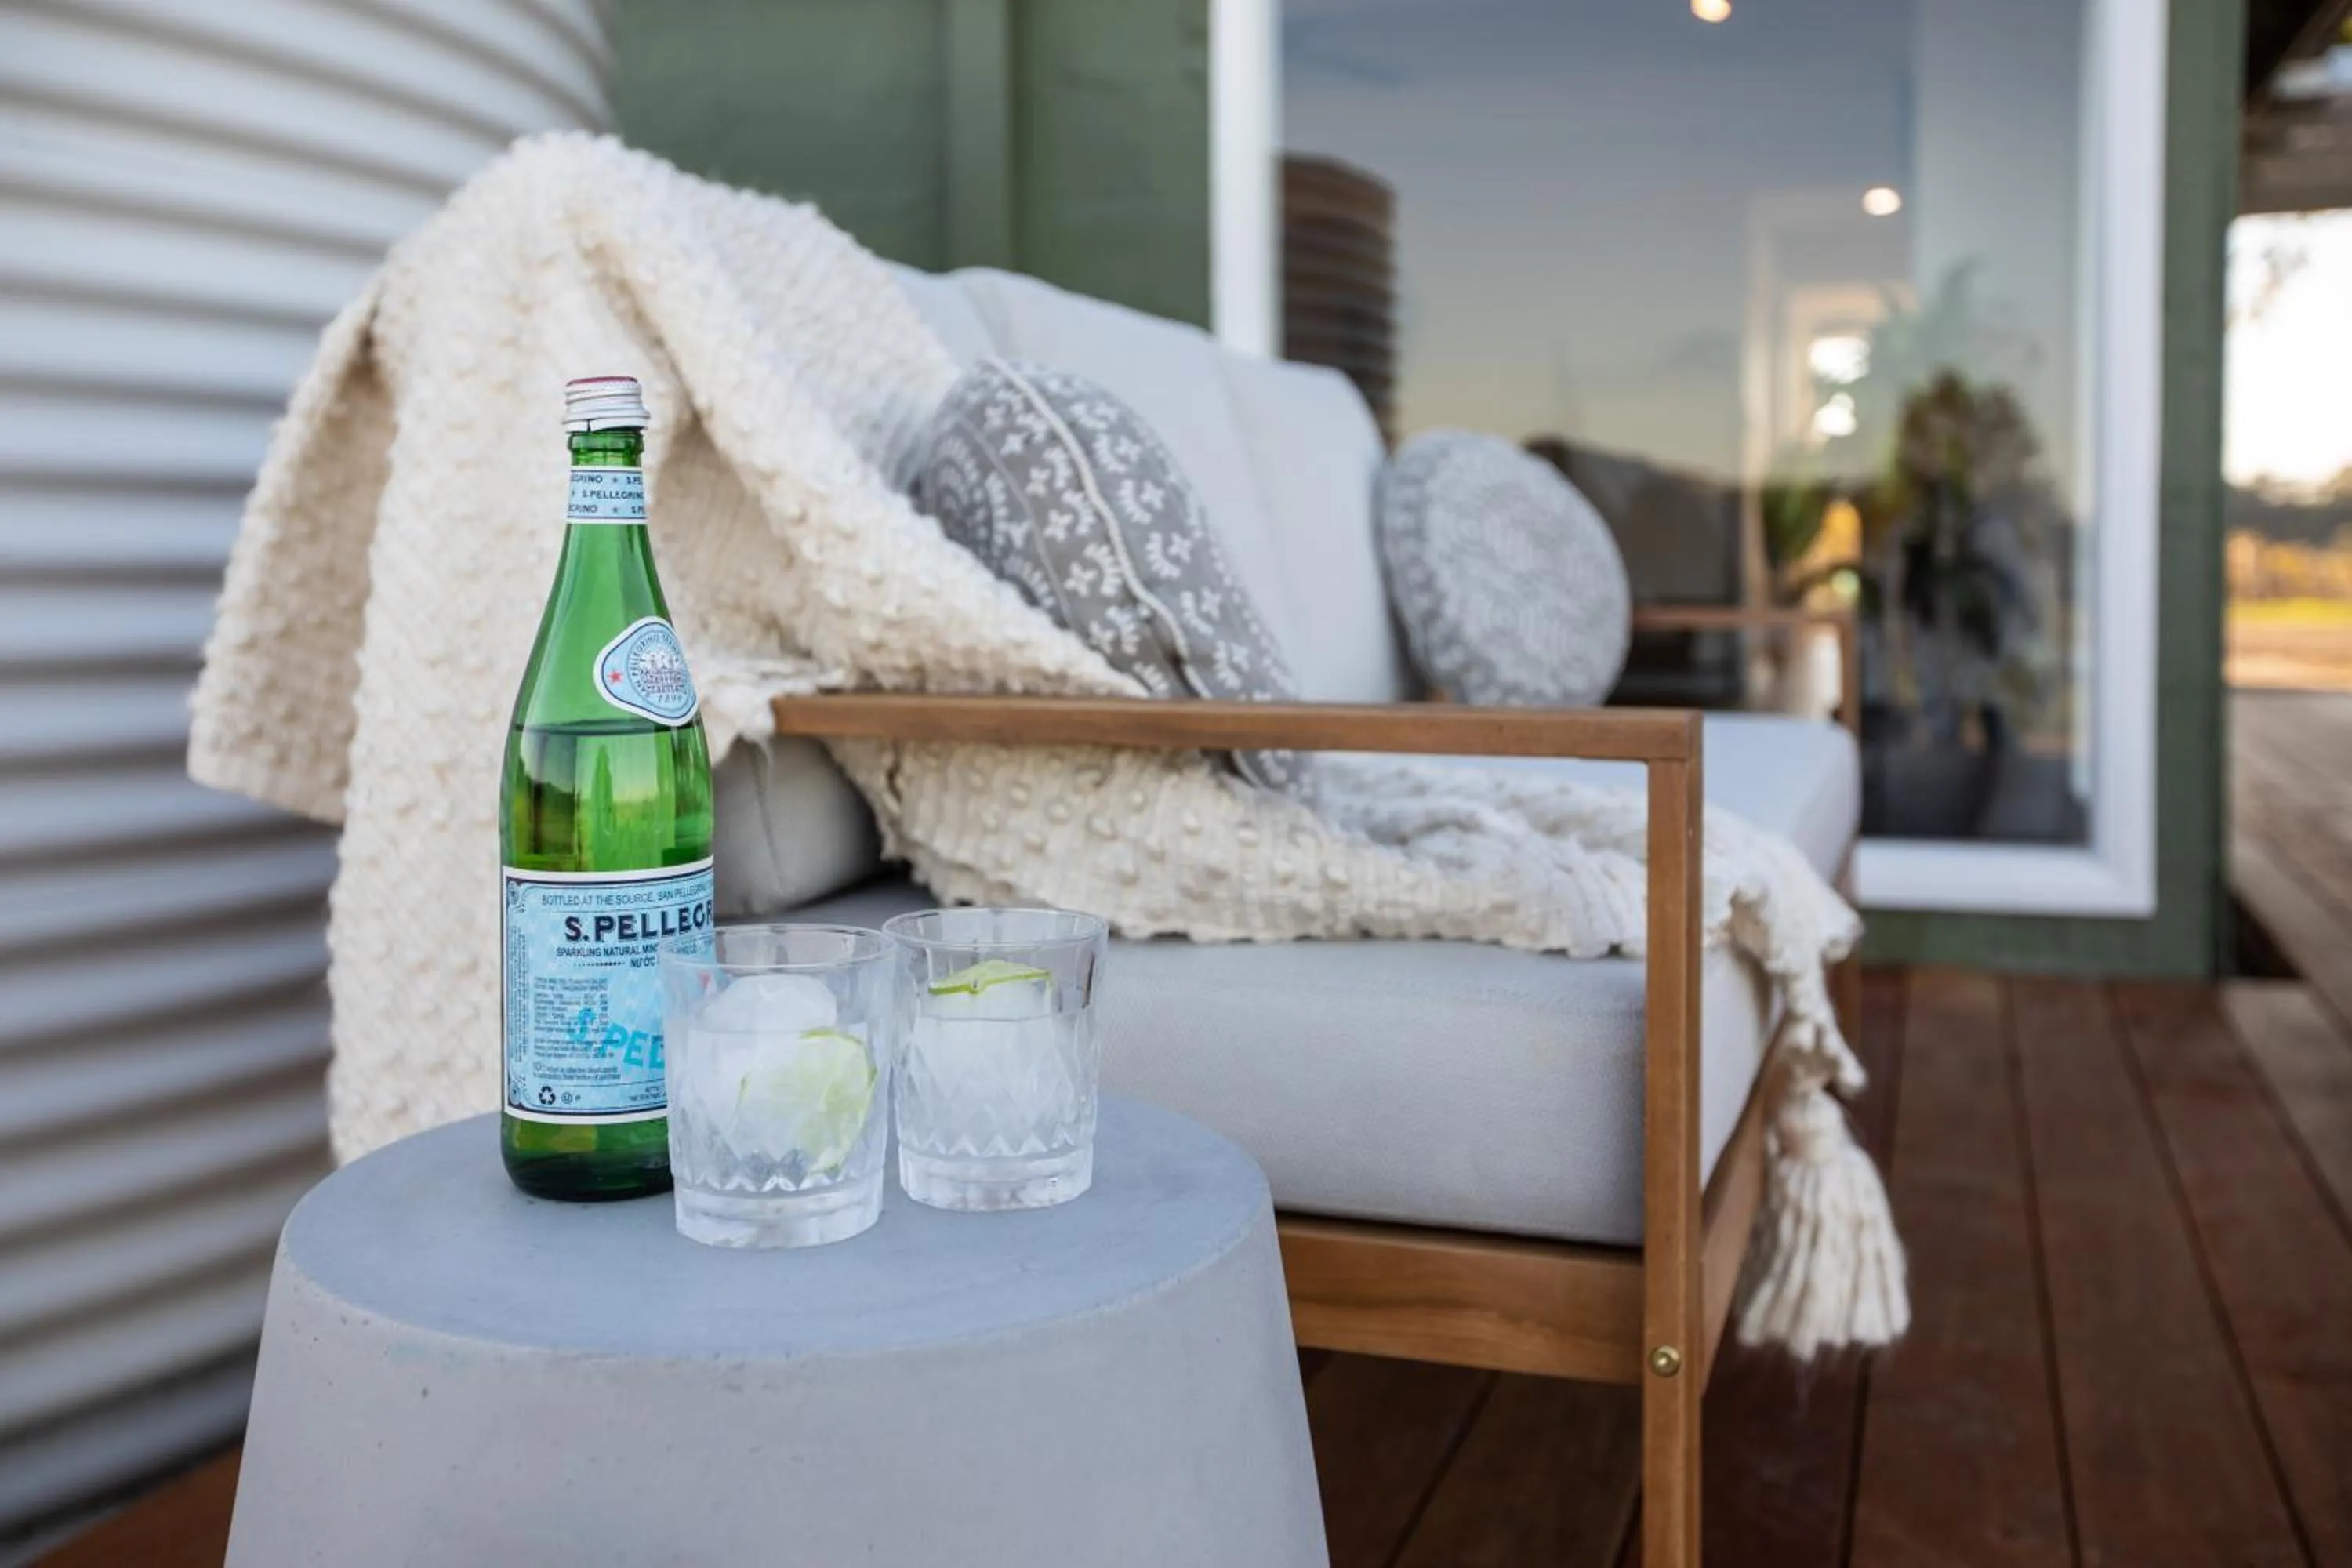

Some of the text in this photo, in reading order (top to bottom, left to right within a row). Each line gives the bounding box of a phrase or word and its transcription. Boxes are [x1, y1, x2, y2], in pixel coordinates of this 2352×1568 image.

[542, 894, 581, 906] BOTTLED
[583, 895, 593, 906] AT
[596, 895, 613, 906] THE
[659, 890, 673, 901] SAN
[556, 946, 601, 957] SPARKLING
[603, 945, 641, 957] NATURAL
